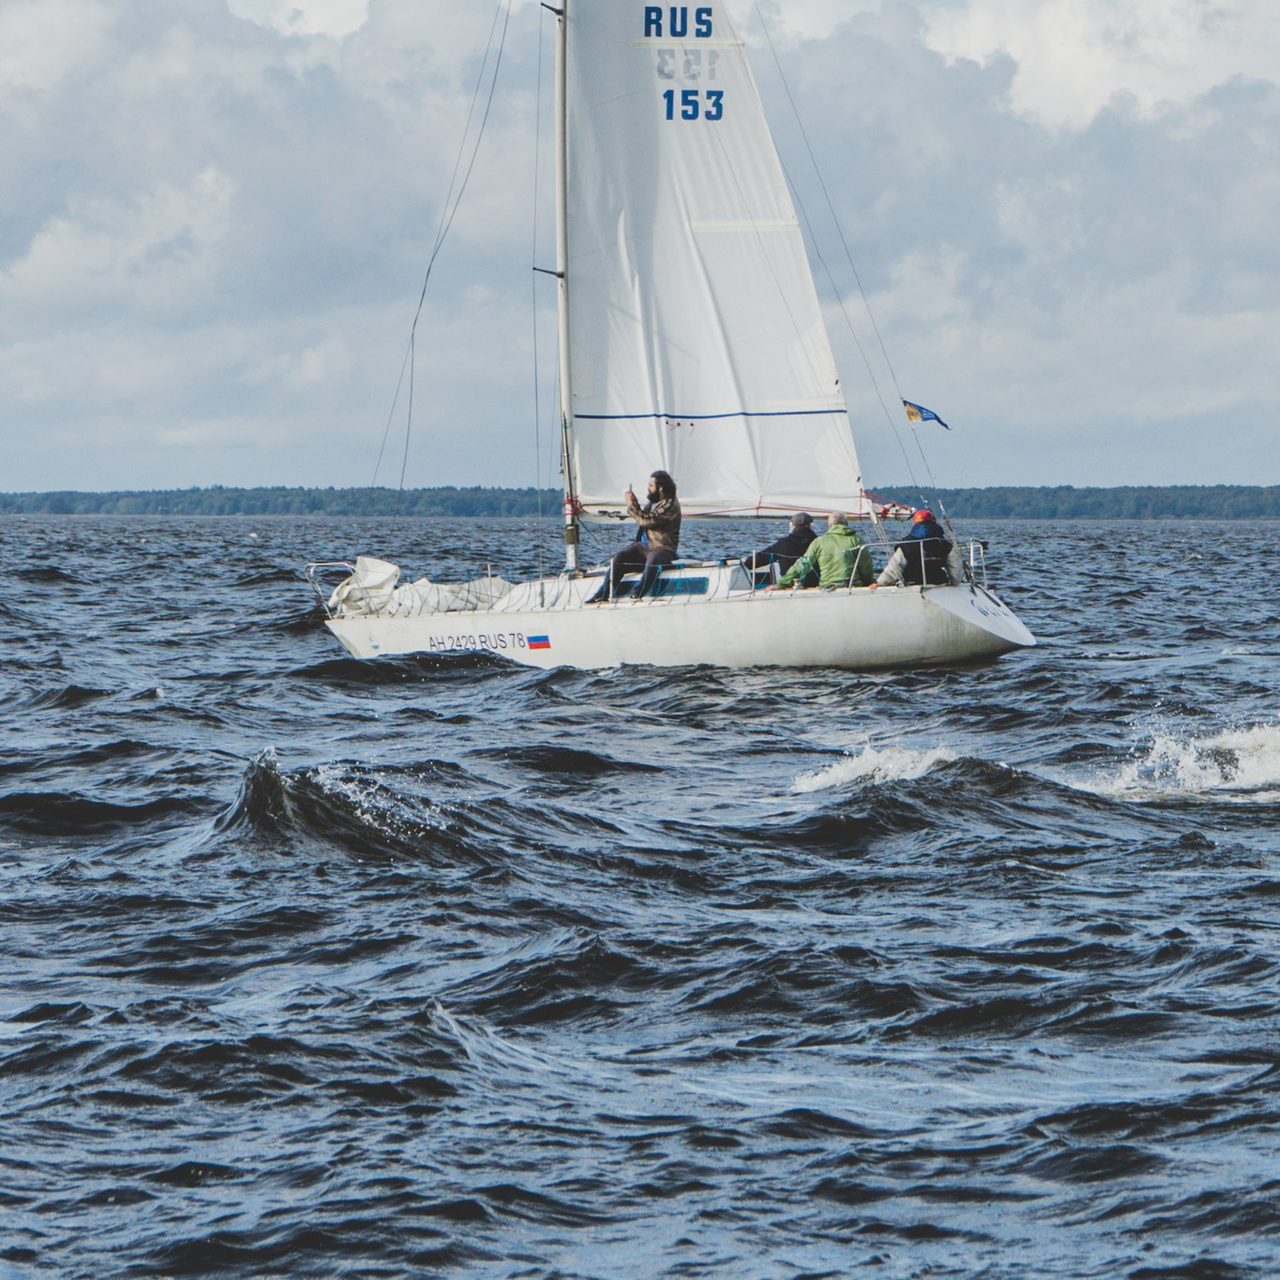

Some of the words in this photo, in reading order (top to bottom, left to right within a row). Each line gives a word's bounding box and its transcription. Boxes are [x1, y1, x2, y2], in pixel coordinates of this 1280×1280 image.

[644, 6, 713, 38] RUS
[663, 89, 724, 121] 153
[429, 636, 447, 650] AH
[447, 635, 477, 650] 2429
[478, 633, 507, 649] RUS
[508, 632, 526, 648] 78
